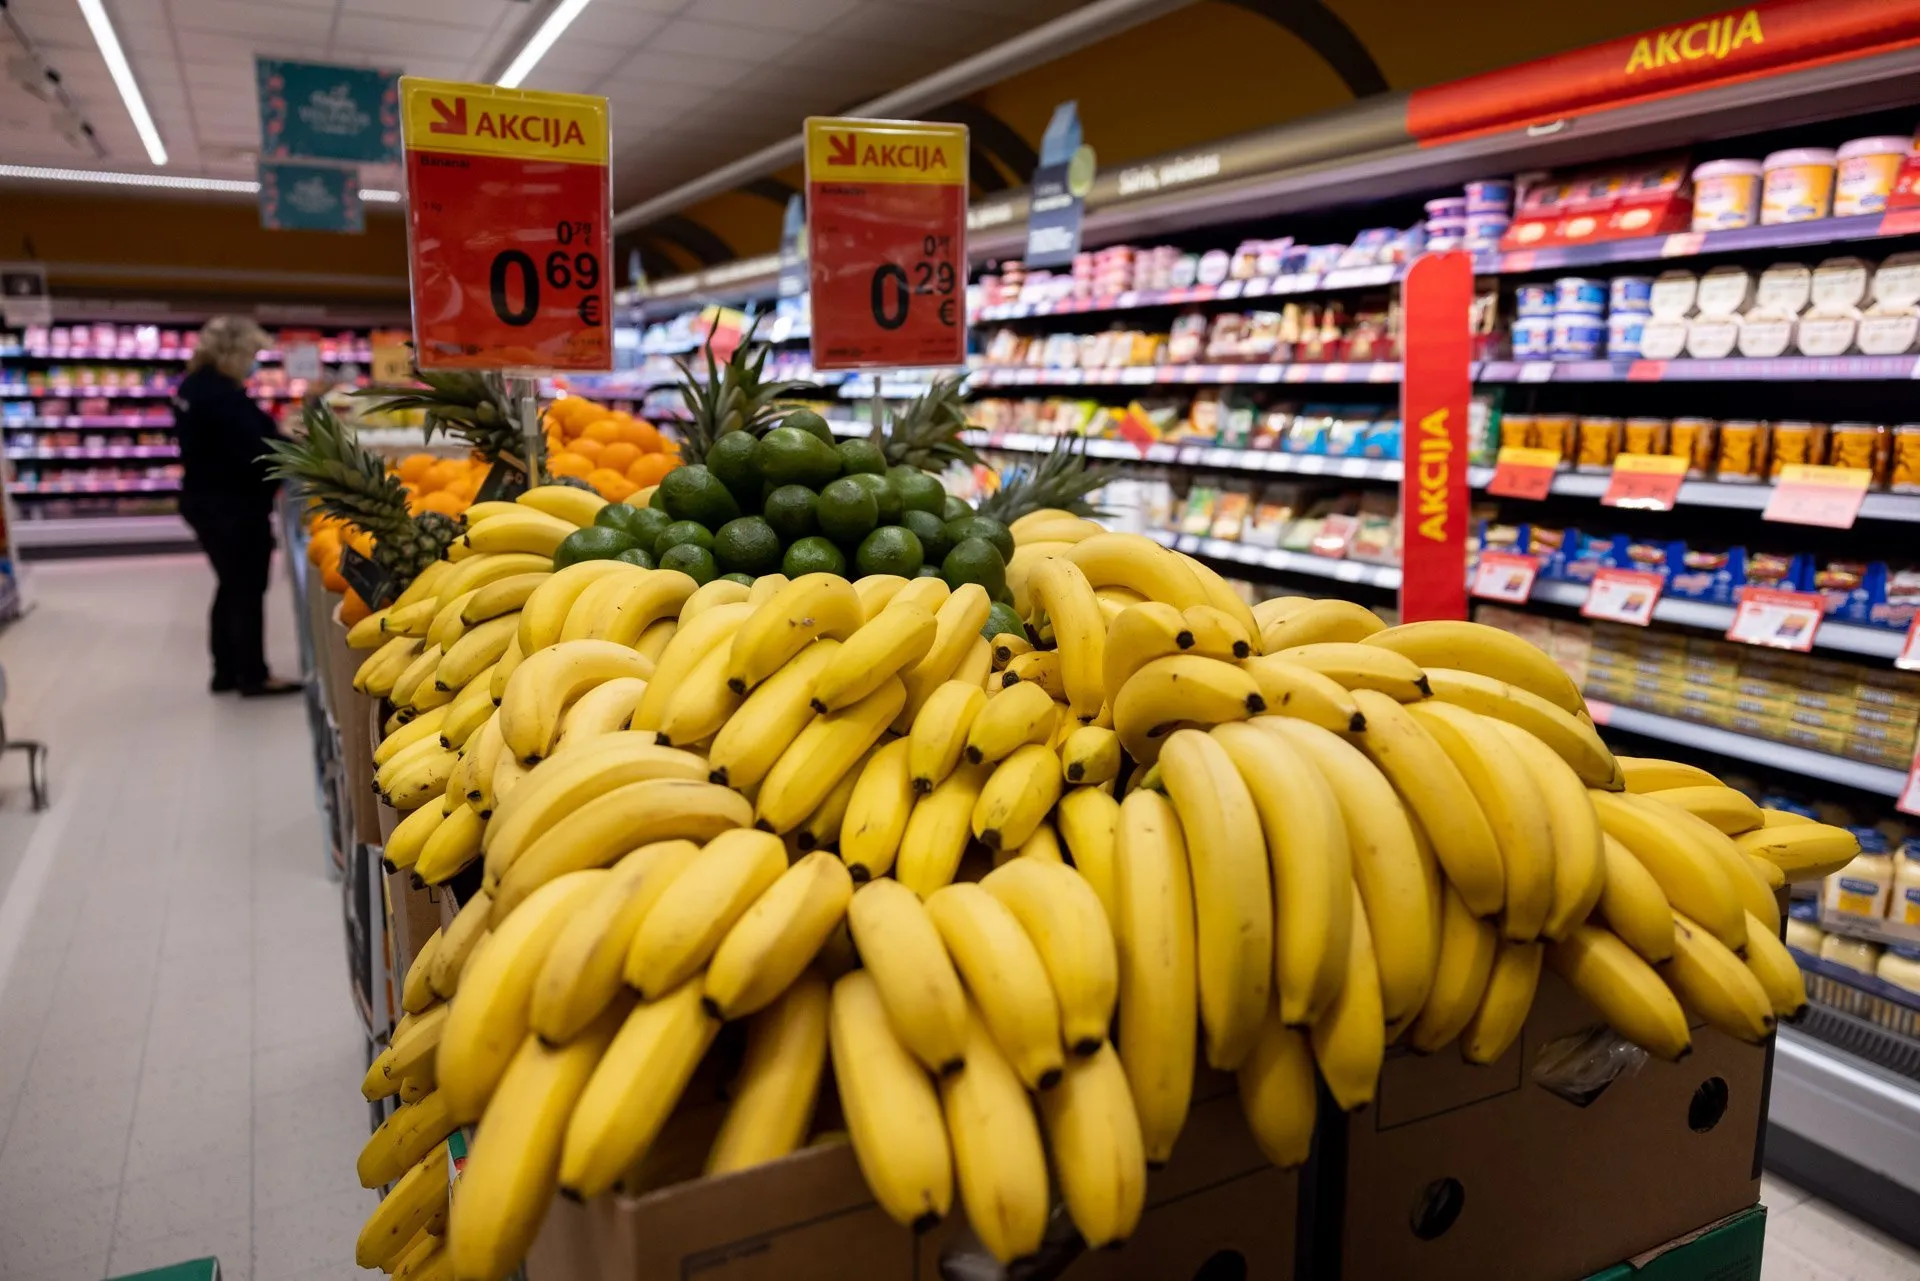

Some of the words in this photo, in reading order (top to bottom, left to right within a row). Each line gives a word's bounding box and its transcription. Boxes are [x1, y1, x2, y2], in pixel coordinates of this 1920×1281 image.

[1625, 9, 1764, 74] AKCIJA
[475, 112, 586, 148] AKCIJA
[862, 143, 947, 171] AKCIJA
[1418, 407, 1454, 542] AKCIJA
